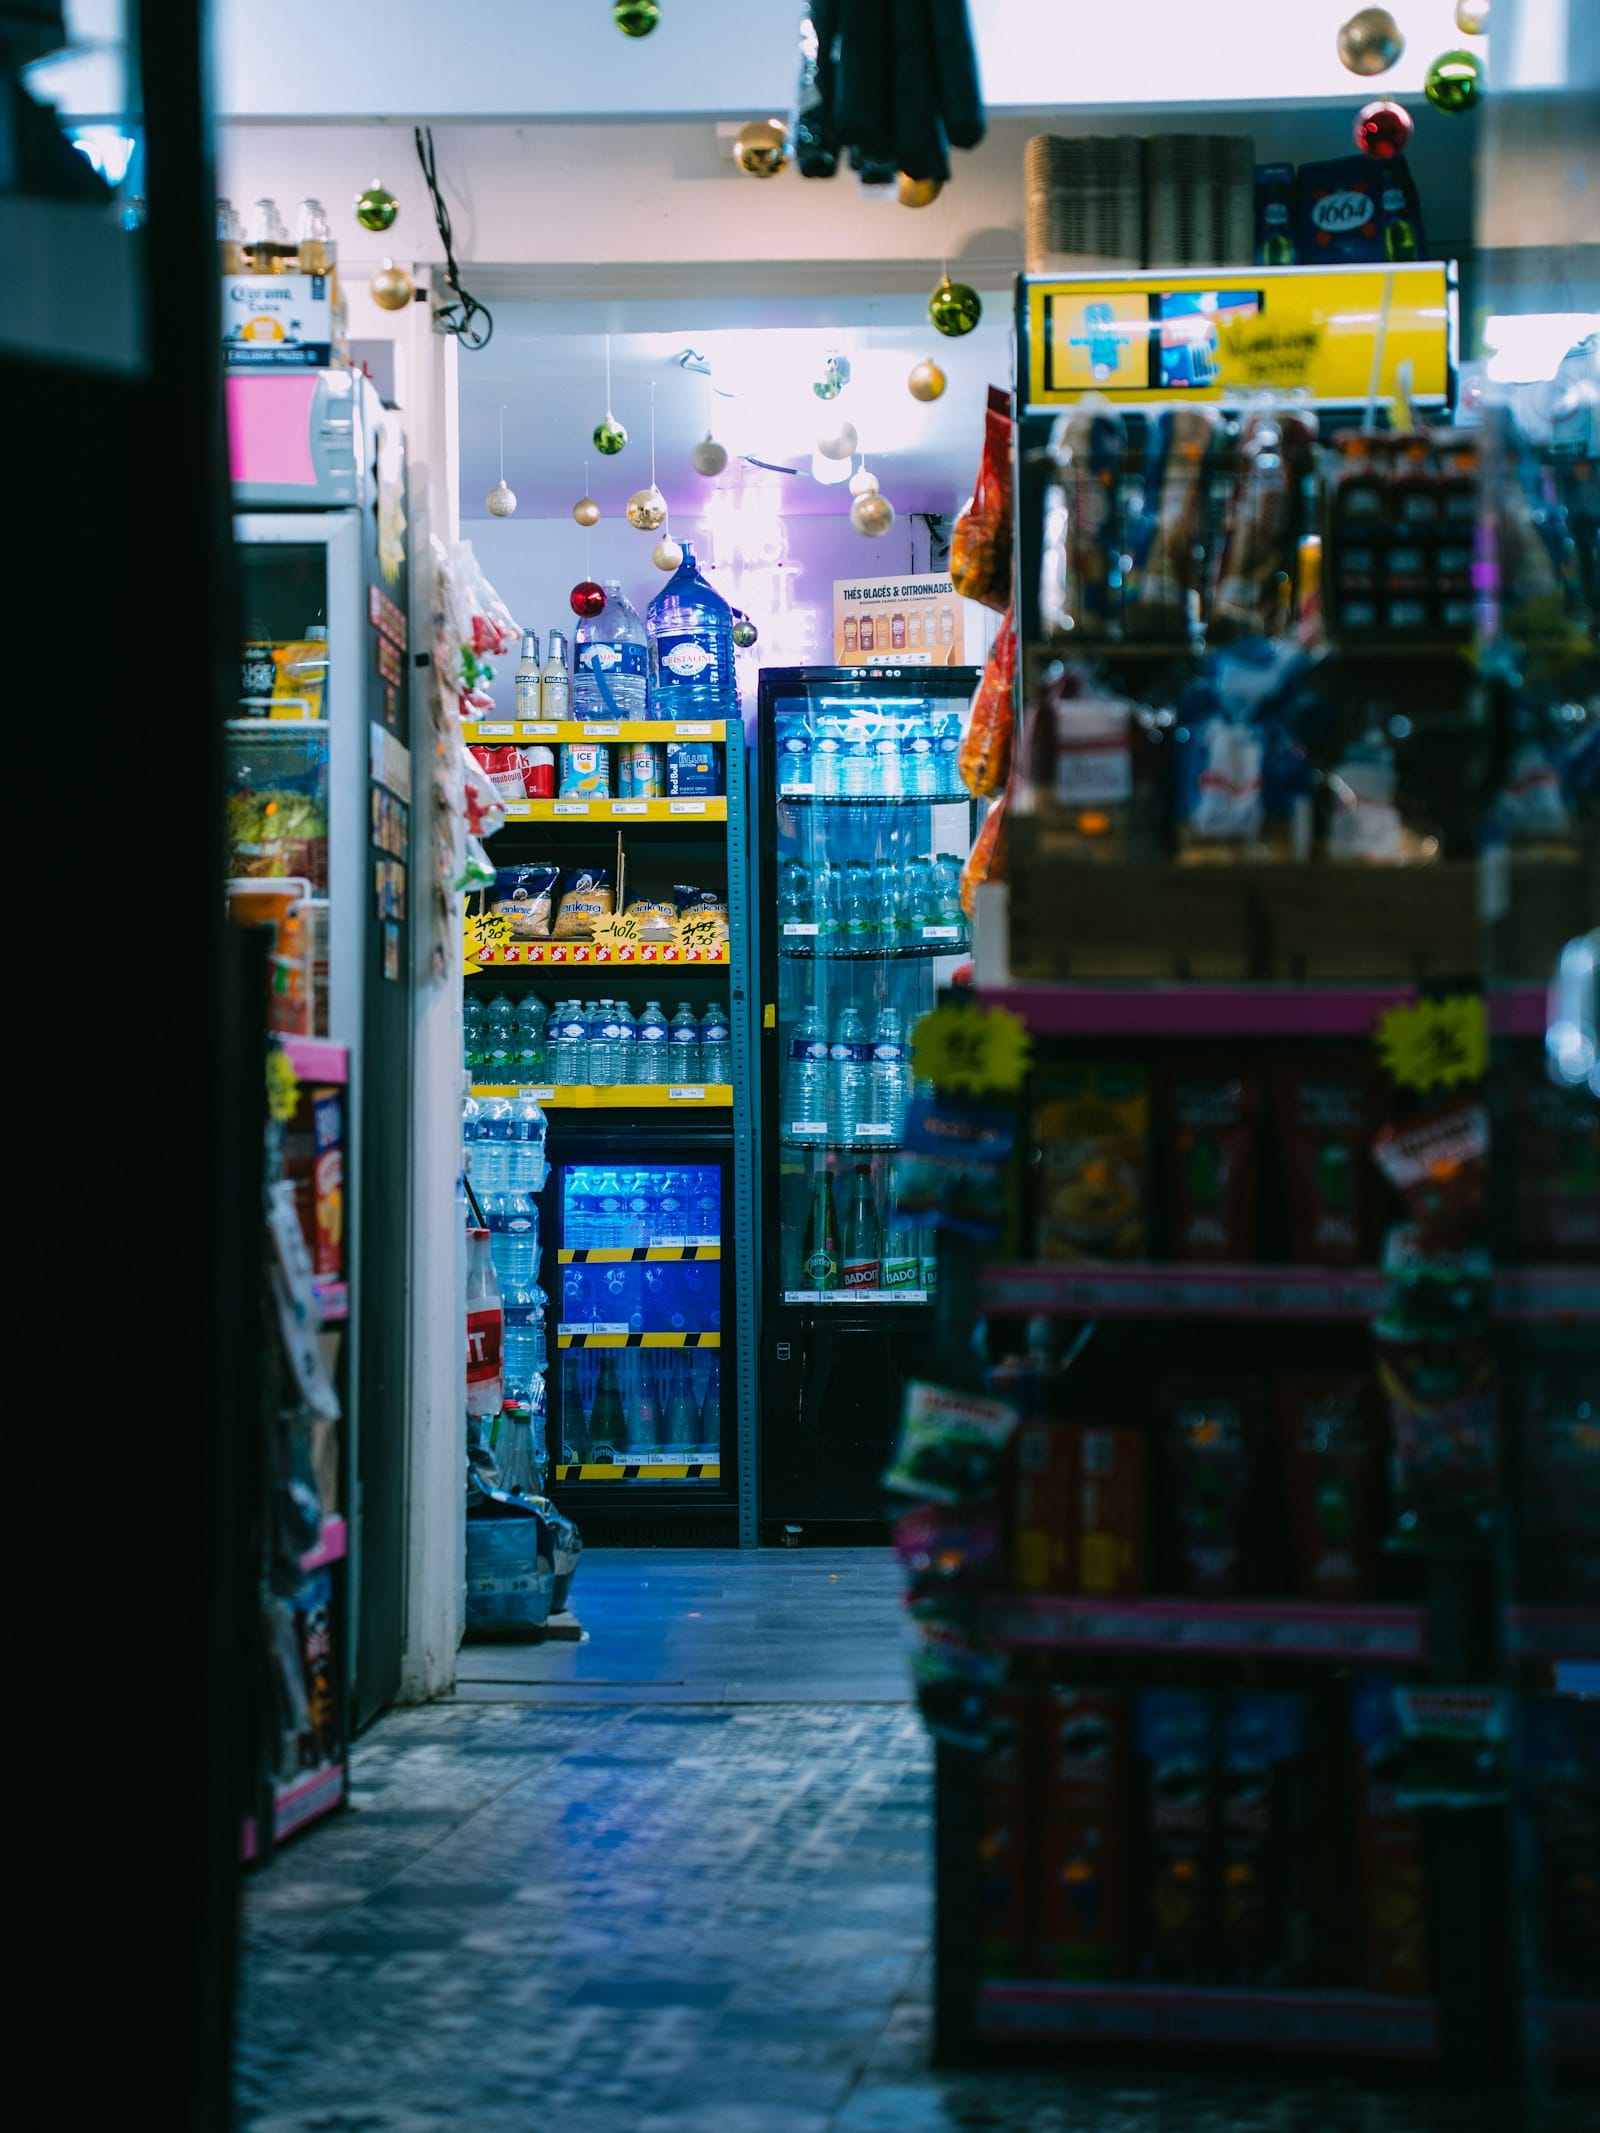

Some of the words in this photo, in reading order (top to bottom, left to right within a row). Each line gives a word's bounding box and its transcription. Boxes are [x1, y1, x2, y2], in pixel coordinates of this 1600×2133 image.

[1317, 197, 1368, 224] 1664
[843, 587, 862, 600] THÉS
[863, 585, 891, 599] GLACÉS
[893, 586, 899, 596] &
[901, 583, 953, 597] CITRONNADES
[577, 752, 592, 761] ICE
[679, 755, 708, 764] BLUE
[637, 760, 651, 769] ICE
[670, 763, 679, 778] Bull
[671, 779, 679, 795] Red
[562, 900, 601, 913] ankara
[631, 902, 673, 917] ankara
[600, 920, 637, 940] -40%
